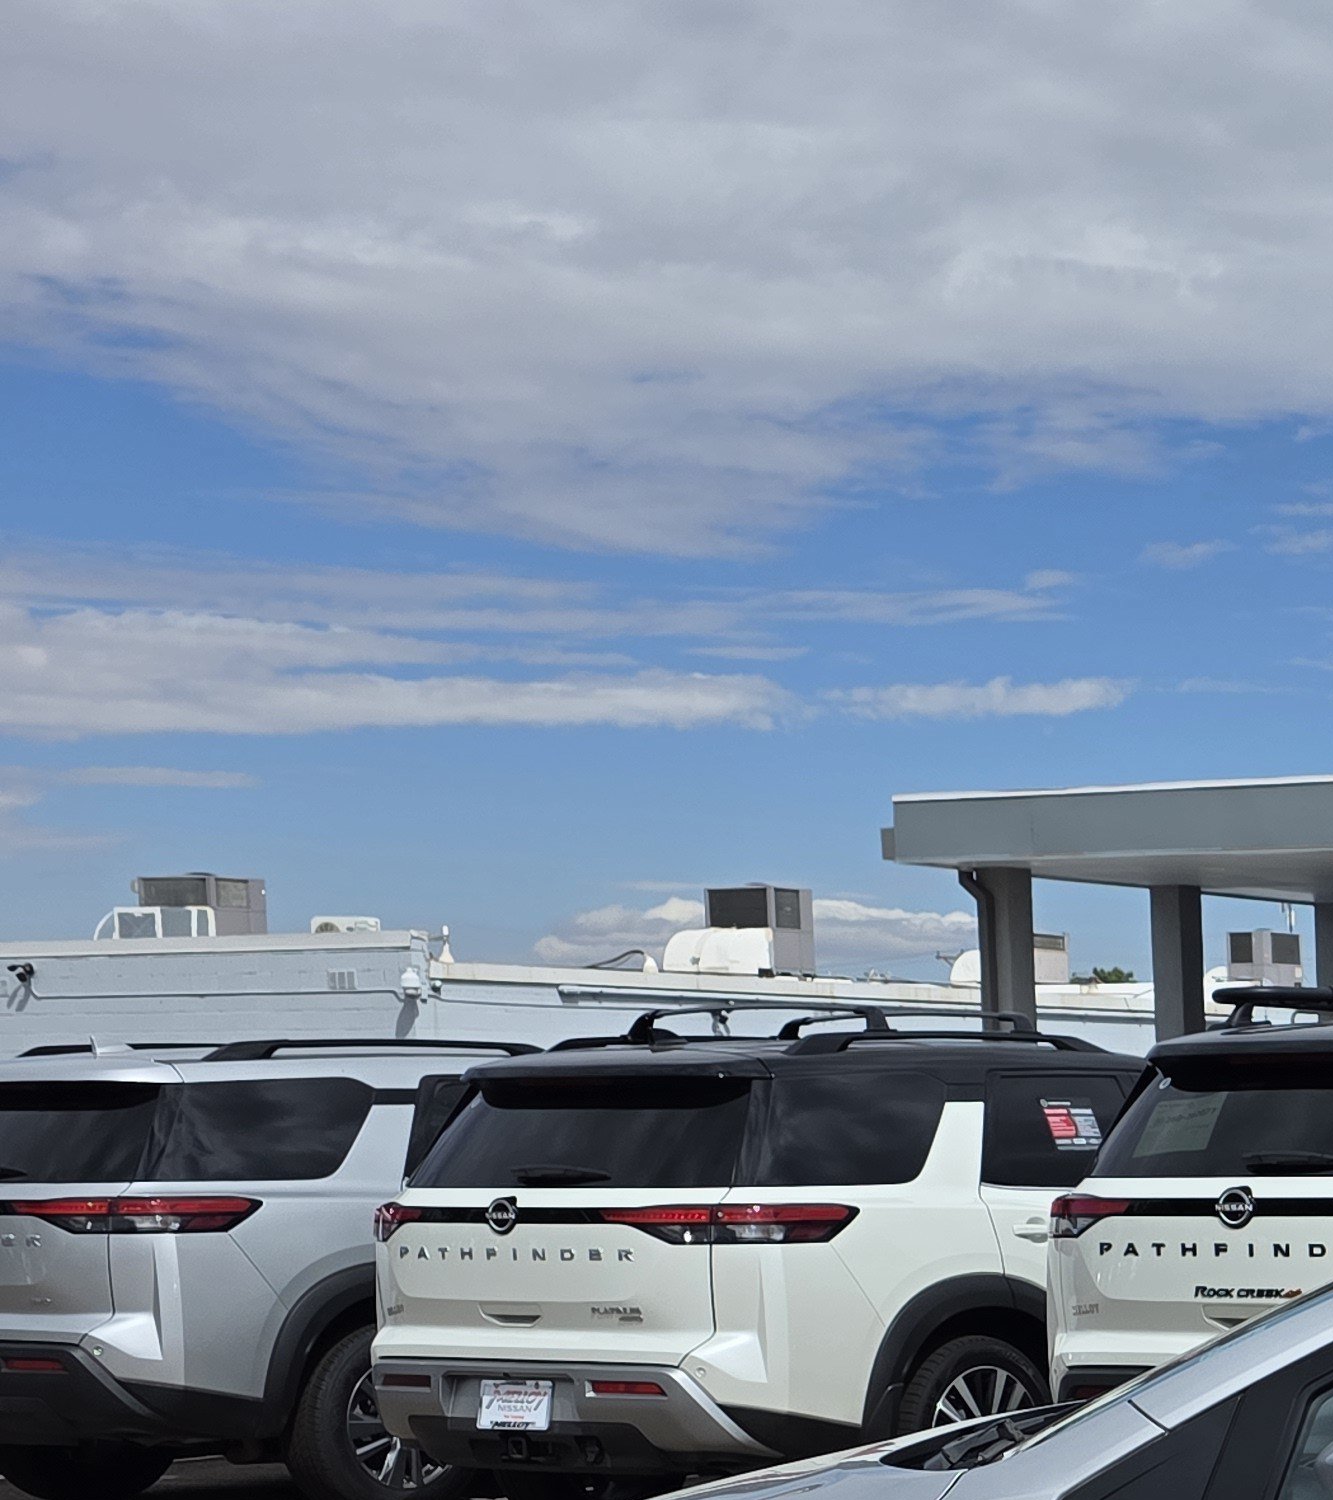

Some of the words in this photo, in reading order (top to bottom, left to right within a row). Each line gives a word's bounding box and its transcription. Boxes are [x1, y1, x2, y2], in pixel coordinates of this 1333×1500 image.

[1214, 1203, 1253, 1212] NISSAN
[399, 1245, 636, 1262] PATHFINDER
[497, 1404, 533, 1413] NISSAN
